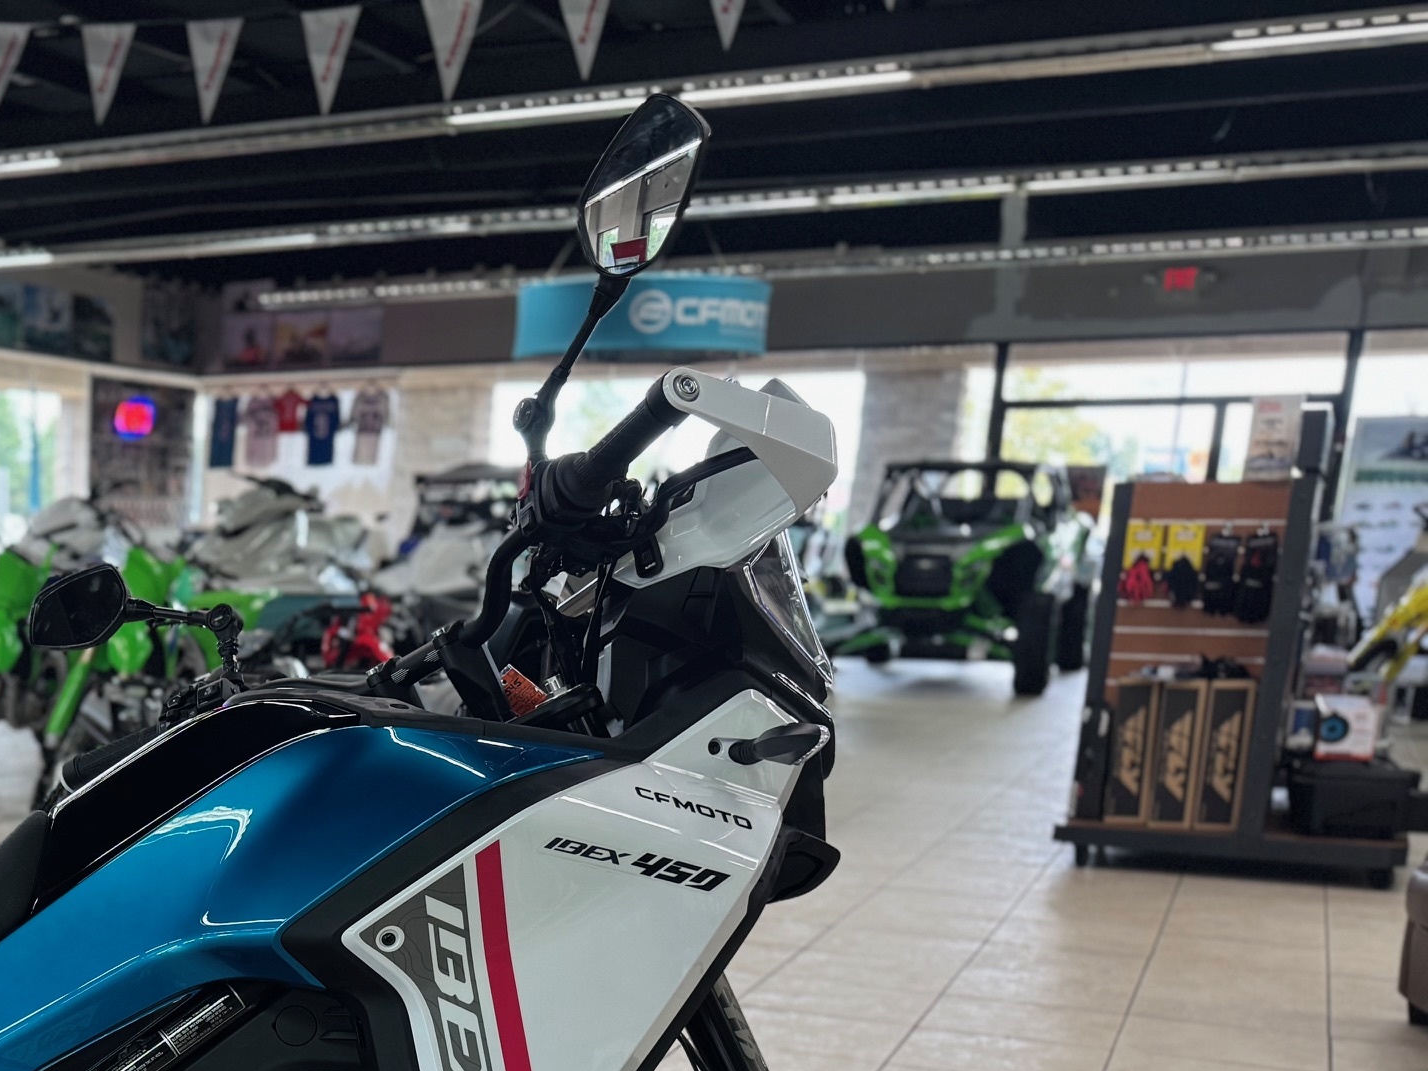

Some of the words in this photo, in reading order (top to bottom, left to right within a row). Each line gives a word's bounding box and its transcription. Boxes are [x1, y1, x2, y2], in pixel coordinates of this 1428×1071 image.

[635, 786, 753, 830] CFMOTO
[544, 837, 631, 866] IBEX
[631, 852, 731, 892] 450
